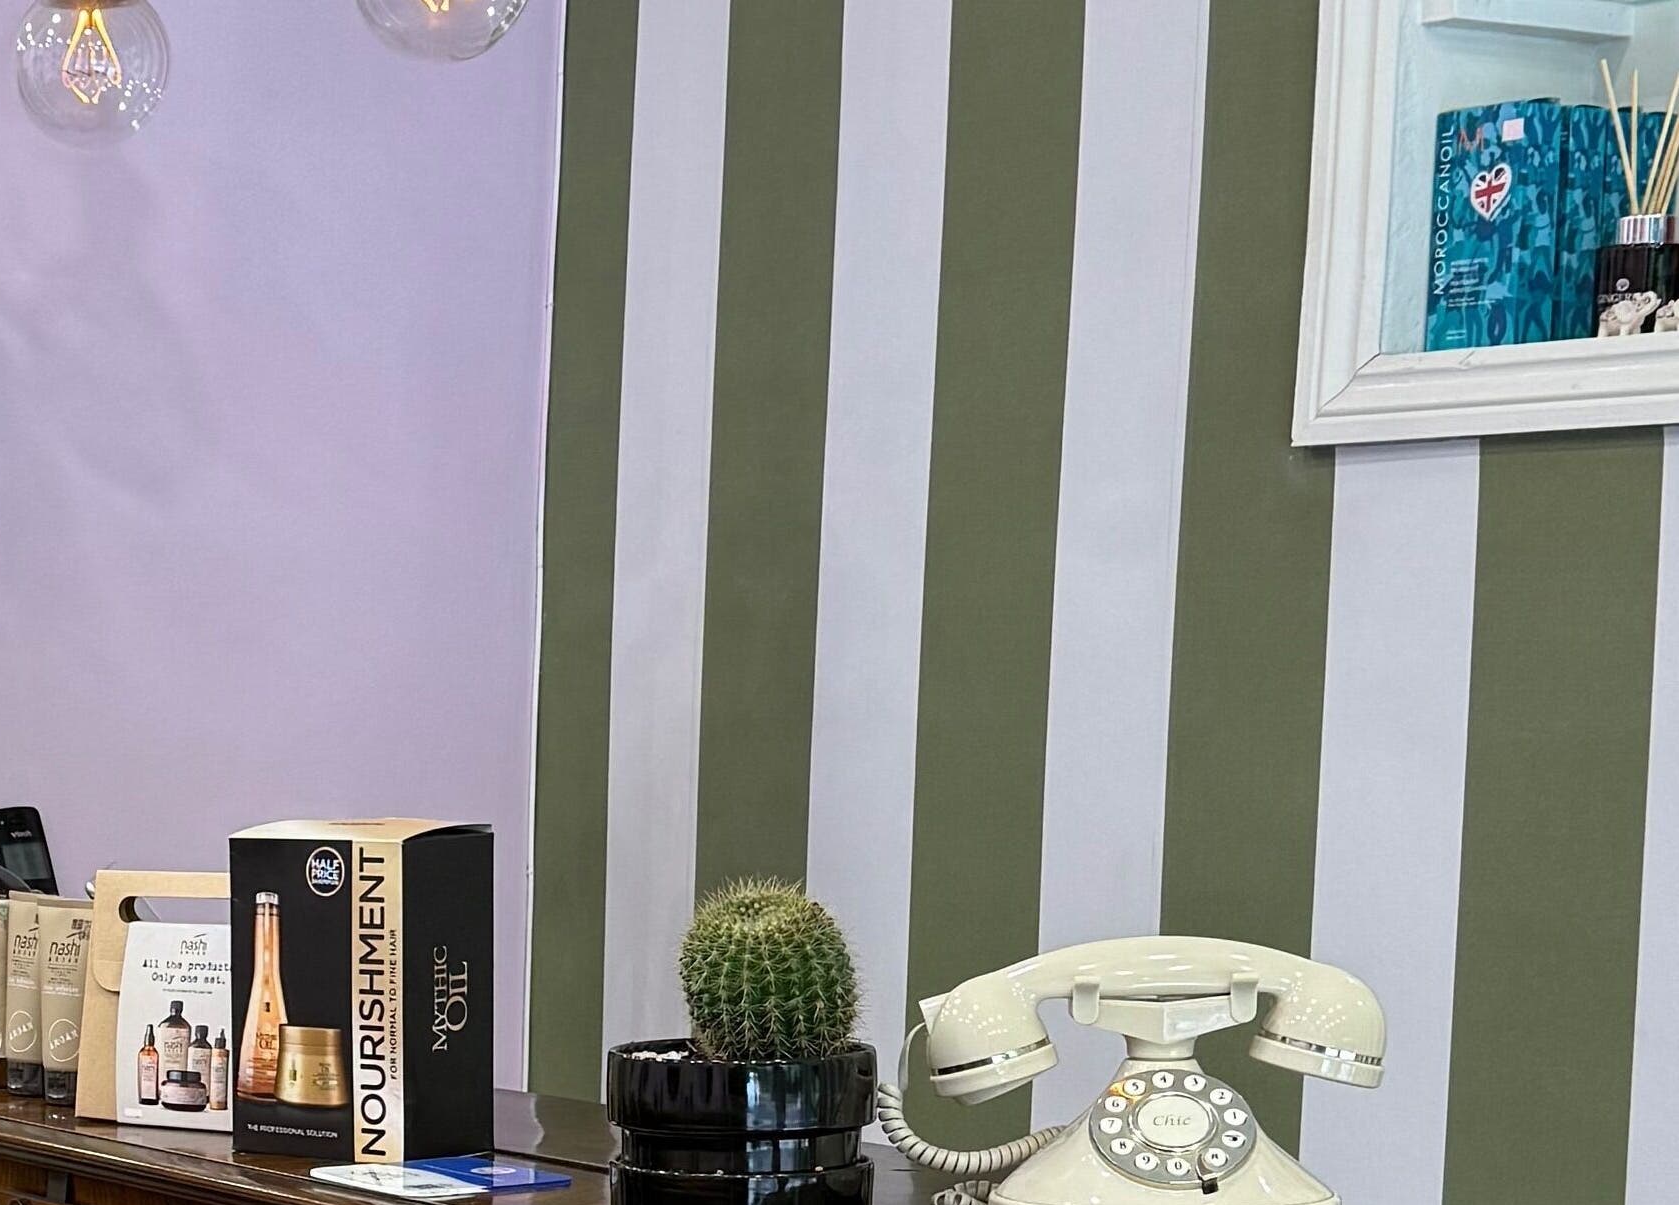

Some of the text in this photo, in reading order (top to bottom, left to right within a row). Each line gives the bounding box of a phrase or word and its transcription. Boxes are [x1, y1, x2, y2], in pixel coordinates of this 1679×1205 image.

[1433, 124, 1455, 295] MOROCCANOIL
[13, 934, 39, 950] nash
[49, 939, 81, 957] nashi
[142, 959, 231, 972] All the product
[151, 971, 176, 985] Only
[180, 975, 198, 984] one
[359, 846, 387, 1156] NOURISHMENT
[432, 945, 448, 1052] MYTHIC
[445, 961, 468, 1032] OIL
[389, 929, 398, 1080] FOR NORMAL TO FINE HAIR
[1131, 1082, 1140, 1091] 5
[1111, 1099, 1120, 1108] 6
[1152, 1114, 1192, 1127] Chic
[1143, 1155, 1151, 1165] 9
[1173, 1161, 1182, 1170] 0
